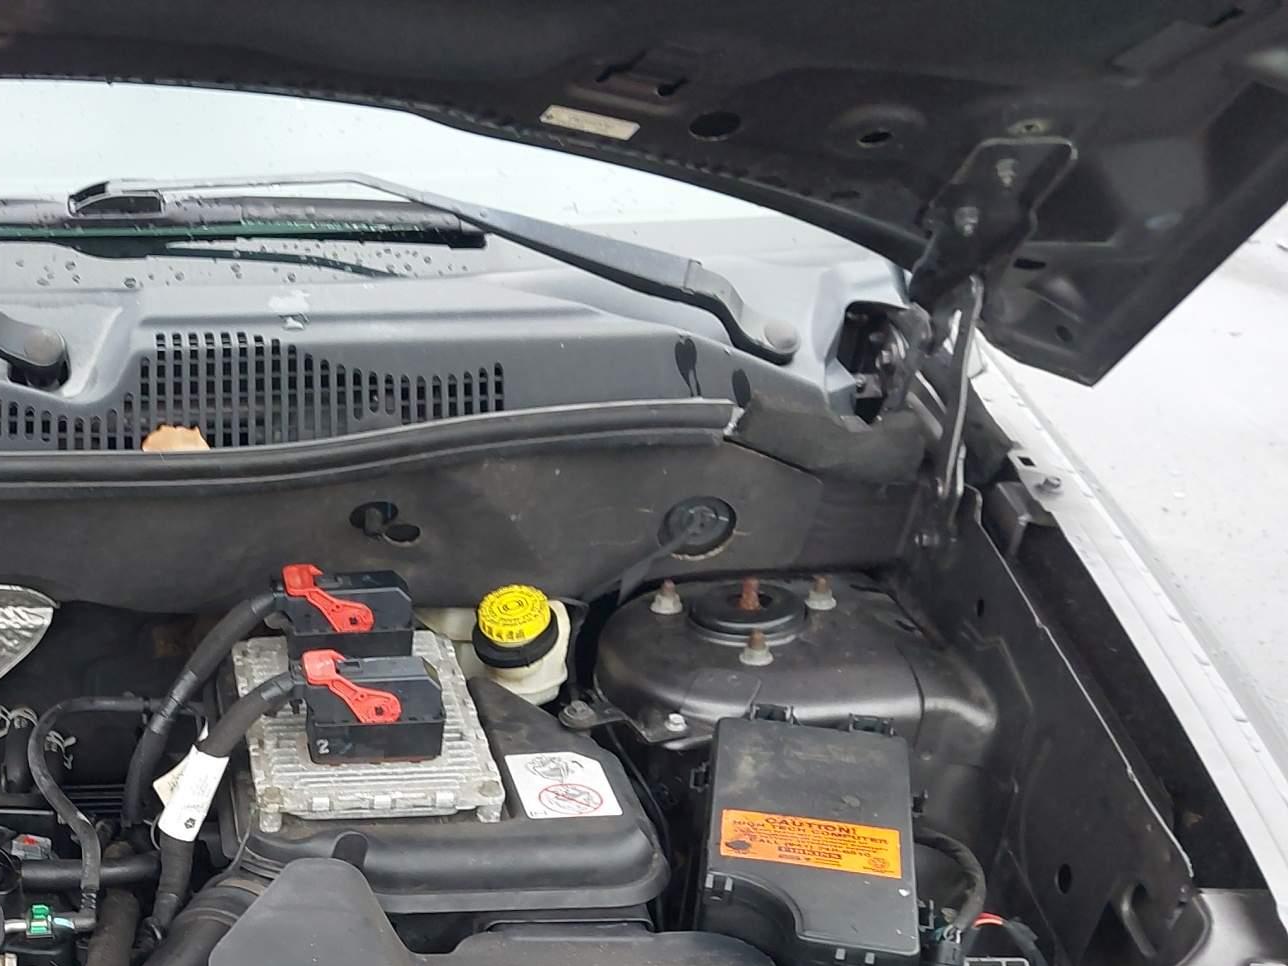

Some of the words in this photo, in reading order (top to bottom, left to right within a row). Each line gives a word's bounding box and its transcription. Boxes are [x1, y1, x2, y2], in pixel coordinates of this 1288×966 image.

[316, 739, 330, 754] 2
[764, 817, 857, 833] CAUTION!
[769, 823, 807, 834] TECH
[810, 830, 889, 845] COMPUTER
